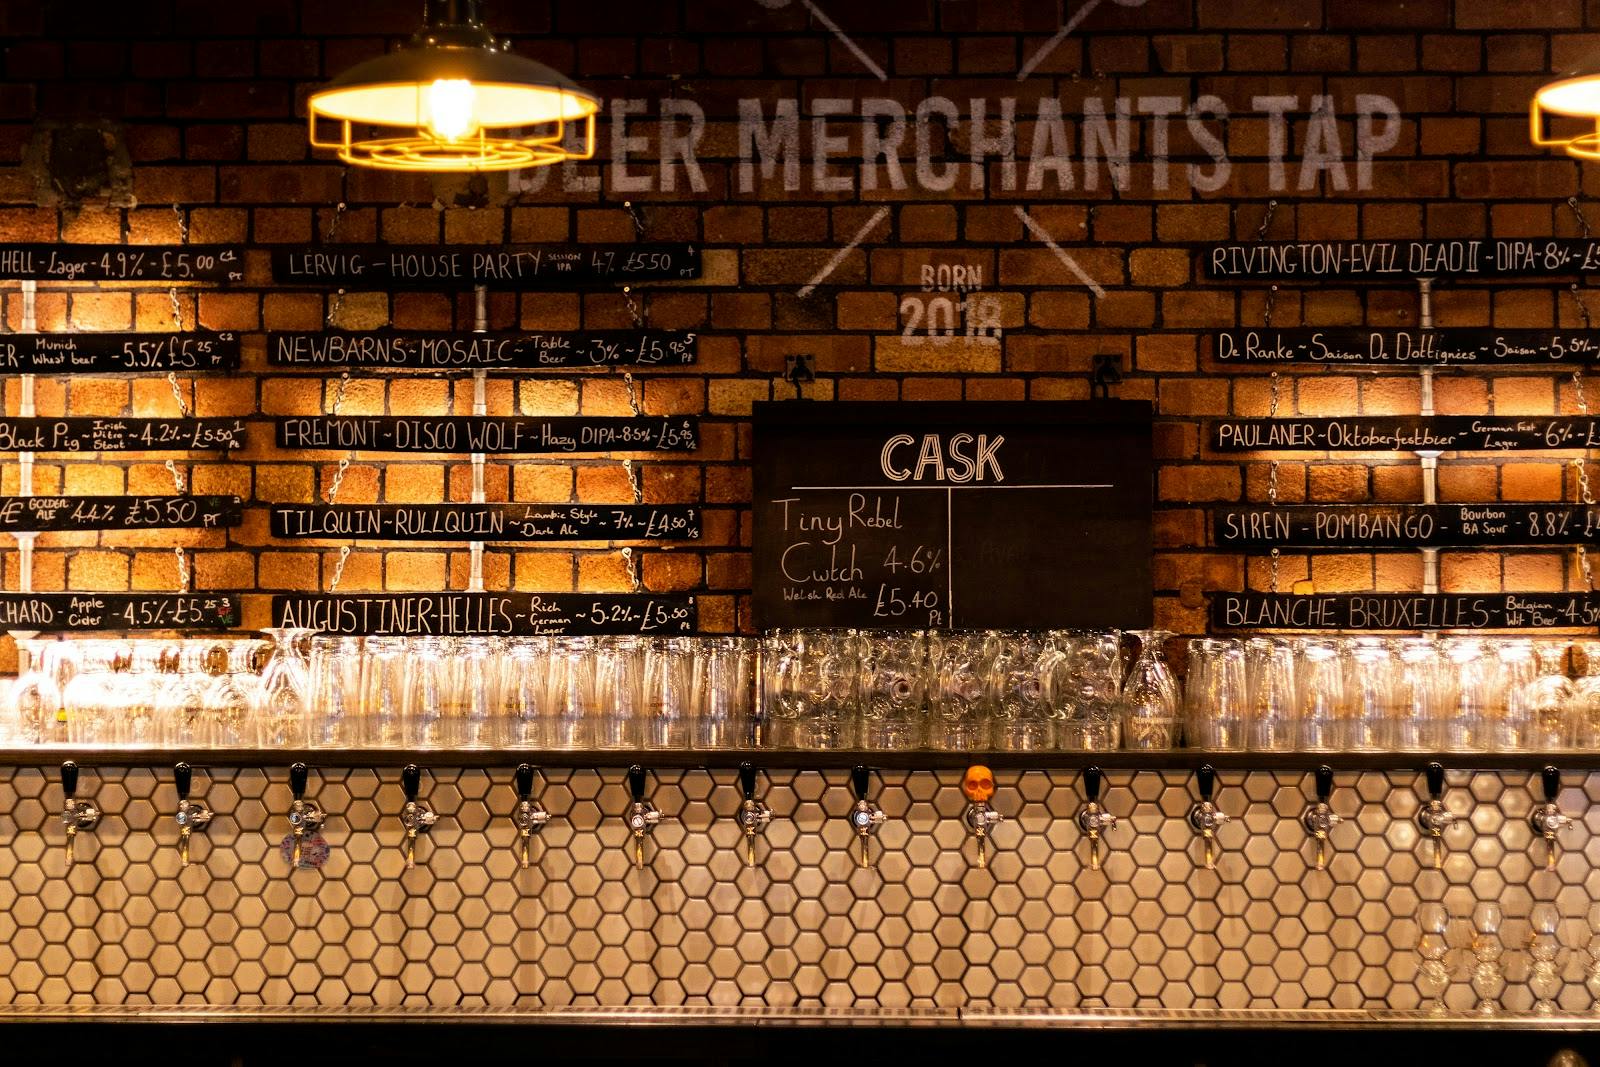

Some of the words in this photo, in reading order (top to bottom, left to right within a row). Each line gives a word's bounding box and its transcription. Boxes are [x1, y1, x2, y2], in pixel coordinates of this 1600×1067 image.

[738, 94, 1232, 194] MERCHANTS
[1252, 93, 1402, 192] TAP
[47, 251, 88, 280] Lager
[100, 252, 145, 278] 4.9%
[289, 253, 365, 276] LERVIG
[391, 252, 463, 278] HOUSE
[473, 250, 542, 279] PARTY
[557, 262, 572, 271] IPA
[1212, 243, 1341, 275] RIVINGTON
[1350, 242, 1403, 274] EVIL
[1408, 242, 1463, 273] DEAD
[1496, 241, 1536, 271] DIPA
[1543, 241, 1571, 270] 8%
[920, 264, 983, 293] BORN
[899, 297, 1002, 346] 2018
[35, 338, 77, 351] Munich
[123, 342, 164, 367] 5.5%
[277, 336, 407, 364] NEWBARNS
[420, 338, 513, 365] MOSAIC
[589, 339, 620, 364] 3%
[531, 335, 571, 349] Table
[1219, 332, 1240, 359] De
[1246, 331, 1295, 360] Ranke
[1309, 332, 1364, 360] Saison
[1369, 332, 1390, 360] De
[1396, 331, 1477, 364] Dottignies
[1493, 336, 1537, 358] Saison
[1549, 336, 1592, 360] 5.5%
[32, 353, 65, 366] Wheat
[71, 353, 97, 365] beer
[539, 350, 567, 364] Beer
[0, 422, 45, 450] Black
[53, 422, 80, 451] Pig
[140, 422, 181, 446] 4.2%
[284, 418, 381, 448] FREMONT
[395, 420, 456, 450] DISCO
[467, 421, 525, 451] WOLF
[541, 422, 577, 451] Hazy
[581, 426, 616, 445] DIPA
[1219, 423, 1316, 447] PAULANER
[1327, 421, 1456, 452] Oktoberfestbier
[1545, 421, 1573, 447] 6%
[1471, 420, 1514, 433] German
[1484, 434, 1519, 451] Lager
[880, 432, 1005, 483] CASK
[28, 497, 69, 511] GOLDEN
[35, 509, 56, 521] ALE
[124, 498, 198, 526] £5.50
[524, 506, 567, 520] Lambic
[570, 507, 598, 525] Style
[1460, 507, 1506, 521] Bourbon
[276, 508, 381, 536] TILQUIN
[395, 508, 504, 536] RULLQUIN
[611, 510, 634, 530] 7%
[520, 522, 556, 537] Dark
[559, 524, 579, 536] Ale
[771, 497, 845, 545] Tiny
[848, 492, 903, 530] Rebel
[1224, 511, 1291, 541] SIREN
[1315, 510, 1434, 540] POMBANGO
[1528, 511, 1570, 538] 8.8%
[1462, 522, 1479, 535] BA
[1482, 521, 1509, 535] Sour
[780, 541, 864, 584] Cwtch
[882, 544, 941, 575] 4.6%
[70, 596, 105, 614] Apple
[531, 595, 562, 613] Rich
[783, 586, 823, 601] Welsh
[826, 586, 845, 600] Red
[848, 586, 868, 600] Ale
[873, 582, 938, 617] £5.40
[1225, 597, 1336, 627] BLANCHE
[1349, 596, 1489, 628] BRUXELLES
[1505, 595, 1553, 614] Belgian
[68, 614, 102, 626] Cider
[123, 599, 169, 626] 4.5%
[280, 597, 432, 633] AUGUSTINER
[439, 596, 513, 634] HELLES
[590, 602, 632, 625] 5.2%
[529, 612, 572, 626] German
[928, 608, 943, 626] Pt
[1505, 610, 1526, 627] Wit
[1532, 611, 1558, 627] Beer
[534, 625, 566, 637] Lager
